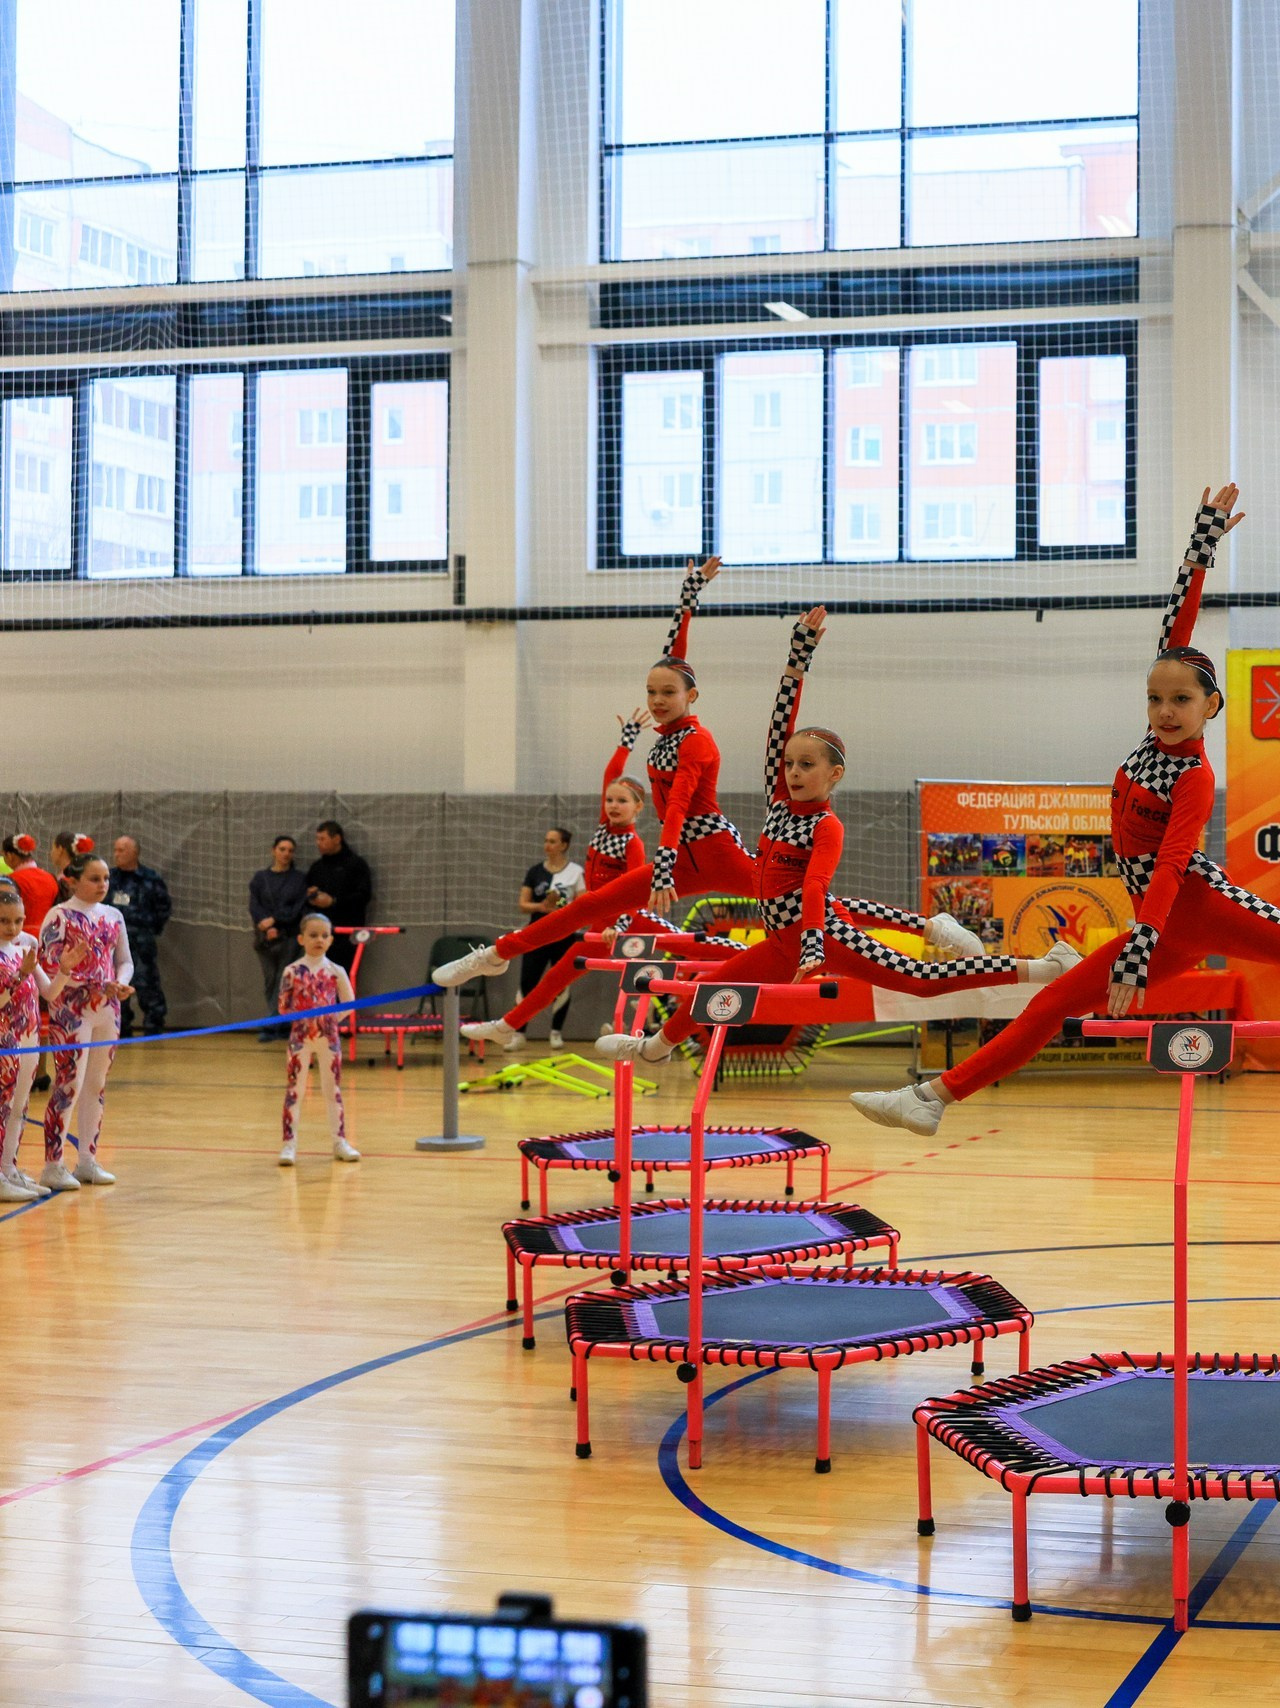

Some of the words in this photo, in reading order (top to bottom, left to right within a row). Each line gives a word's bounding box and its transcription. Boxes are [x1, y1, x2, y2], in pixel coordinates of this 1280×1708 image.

[957, 792, 1036, 809] ФЕДЕРАЦИЯ
[1003, 813, 1069, 830] ТУЛЬСКОЙ
[1073, 815, 1113, 830] ОБЛАС
